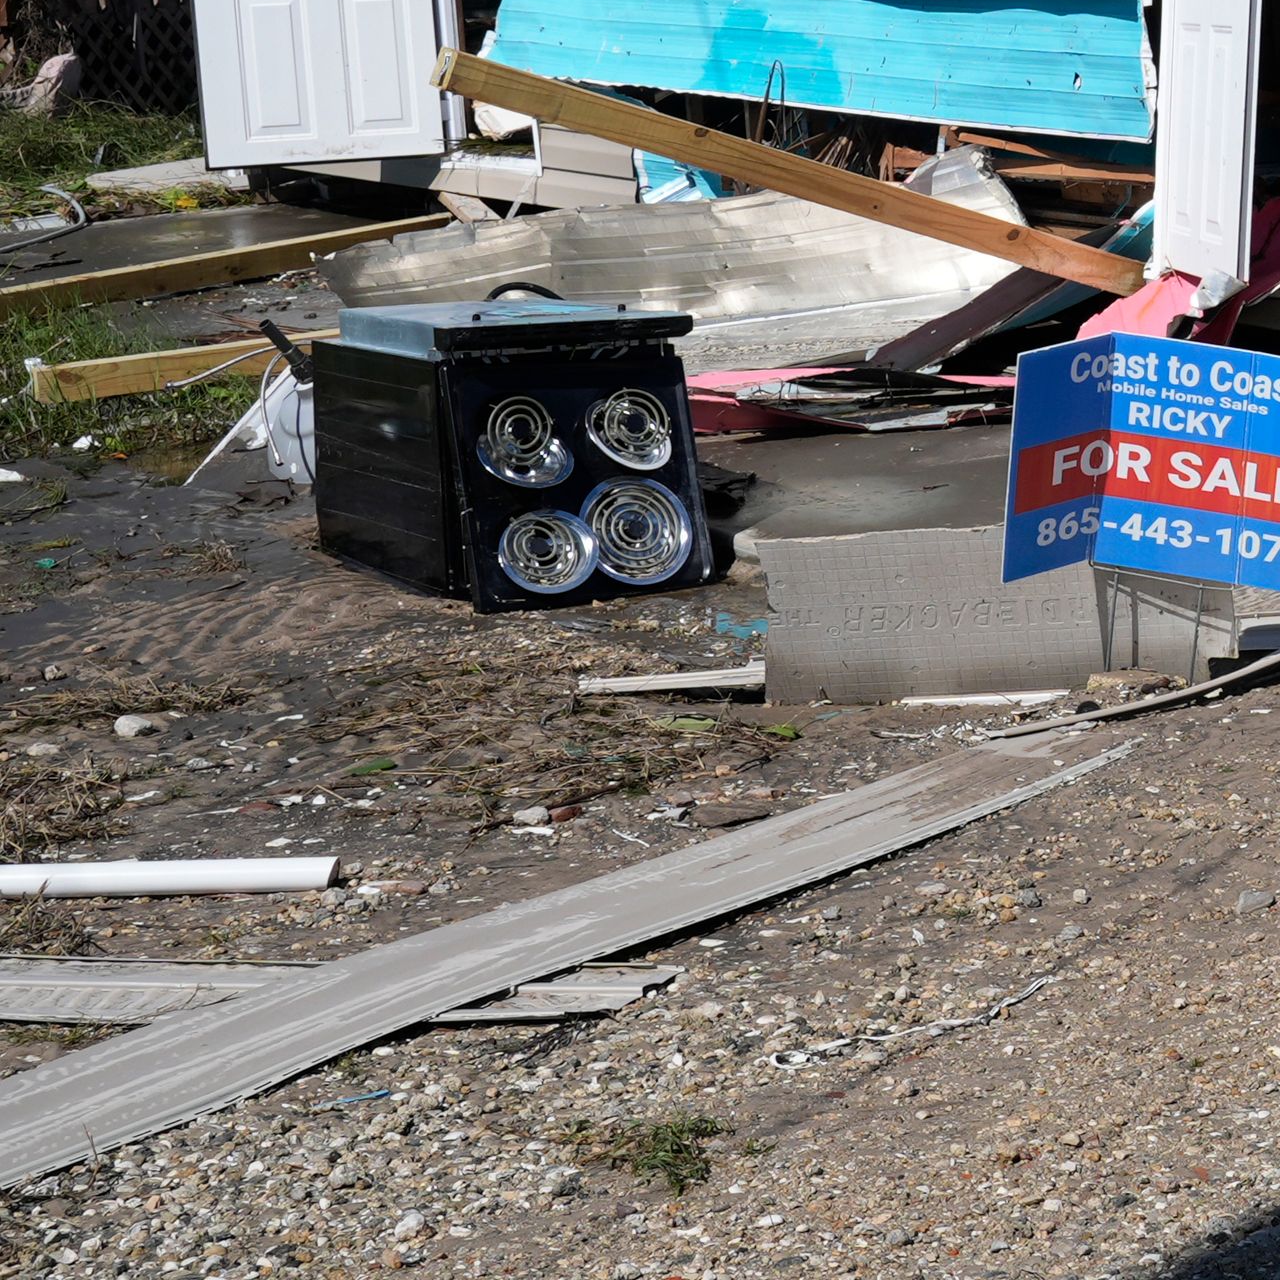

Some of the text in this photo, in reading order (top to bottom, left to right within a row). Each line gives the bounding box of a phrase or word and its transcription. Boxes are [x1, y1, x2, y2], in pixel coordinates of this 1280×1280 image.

[1070, 352, 1159, 383] Coast
[1167, 355, 1201, 387] to
[1097, 381, 1270, 416] Mobile Home Sales
[1127, 401, 1234, 439] RICKY
[1051, 439, 1151, 486] FOR
